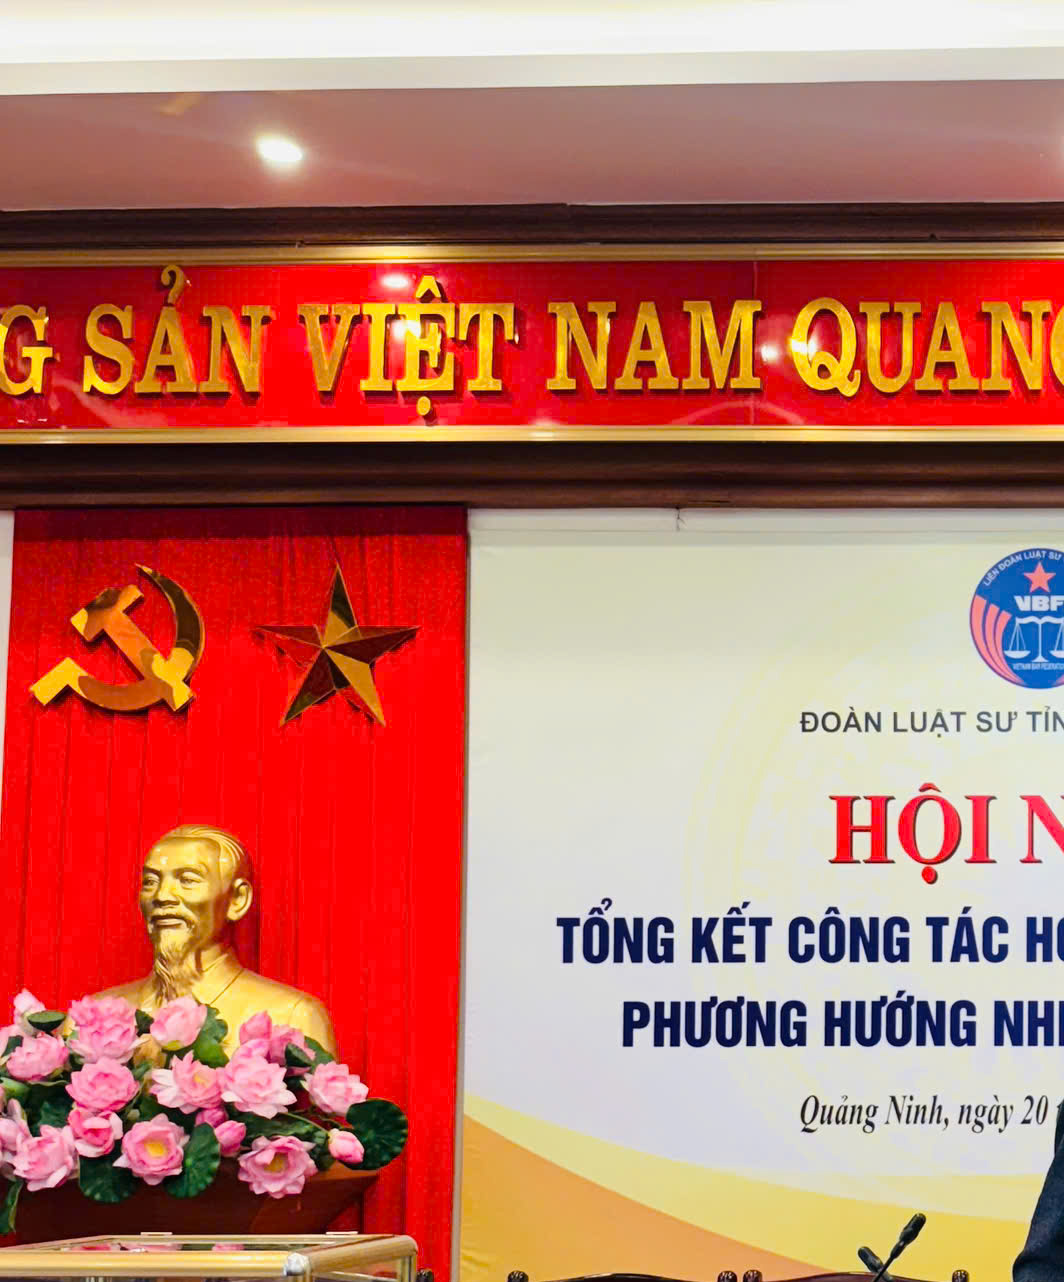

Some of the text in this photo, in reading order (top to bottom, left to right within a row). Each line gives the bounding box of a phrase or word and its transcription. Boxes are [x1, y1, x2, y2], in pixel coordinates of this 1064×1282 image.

[83, 265, 274, 396] SẢN
[298, 275, 517, 417] VIỆT
[548, 300, 762, 392] NAM
[799, 706, 883, 733] ĐOÀN
[893, 707, 967, 738] LUẬT
[976, 710, 1018, 733] SƯ
[828, 782, 997, 885] HỘI
[556, 897, 675, 964] TỔNG
[691, 901, 773, 964] KẾT
[788, 906, 910, 964] CÔNG
[925, 906, 1009, 963] TÁC
[622, 996, 808, 1048] PHƯƠNG
[823, 989, 977, 1047] HƯỚNG
[800, 1094, 1049, 1133] Quảng Ninh, ngày 20
